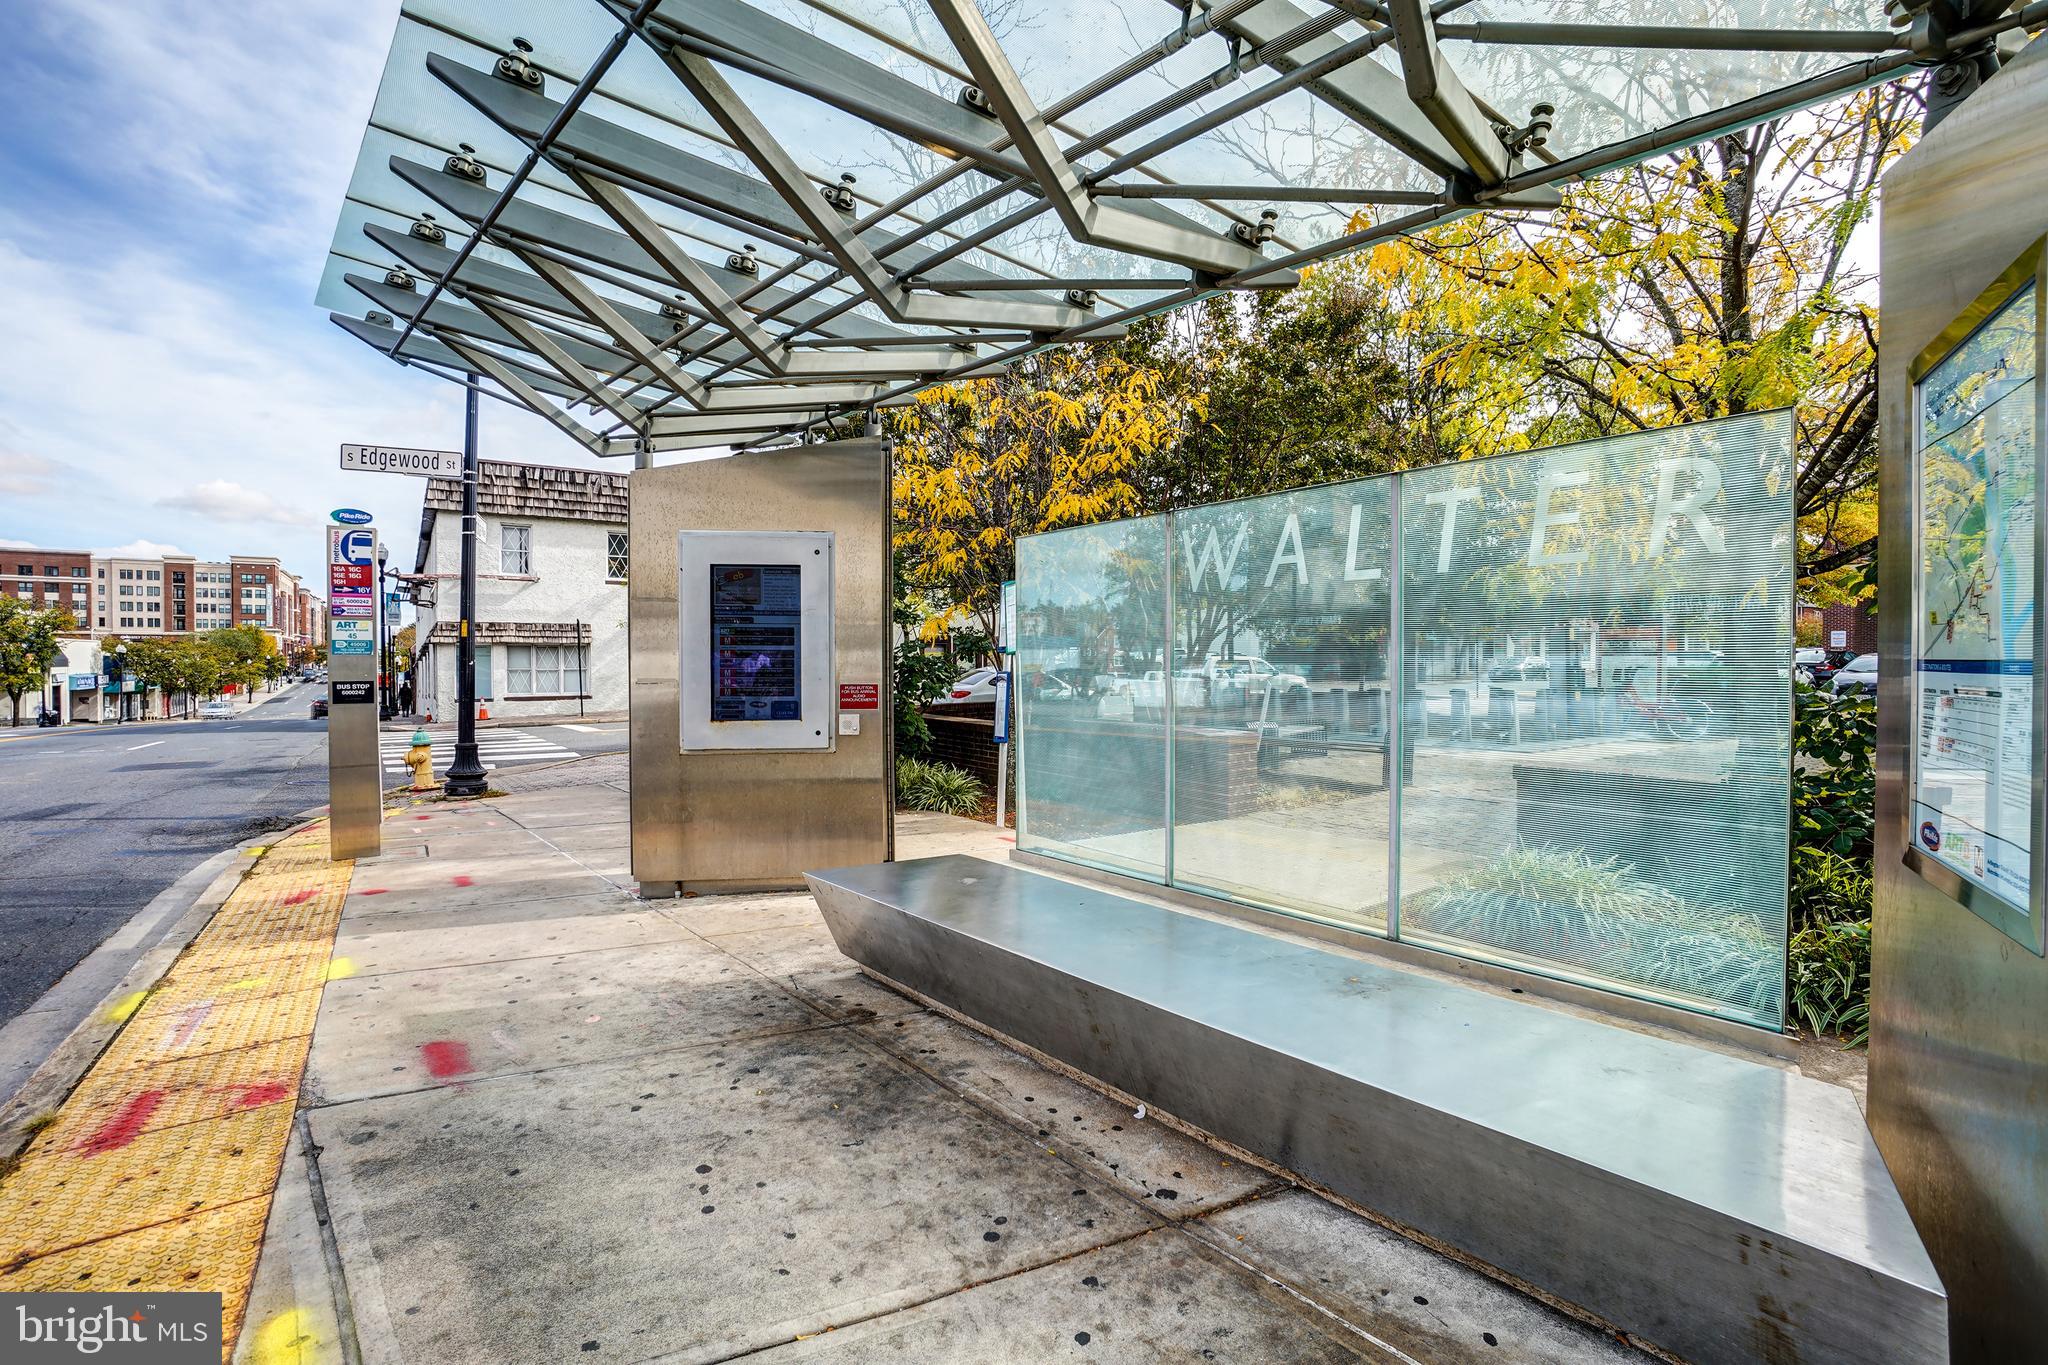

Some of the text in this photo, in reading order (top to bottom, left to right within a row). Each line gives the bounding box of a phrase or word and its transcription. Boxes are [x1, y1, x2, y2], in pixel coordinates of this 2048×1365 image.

[360, 447, 440, 471] Edgewood
[446, 460, 456, 470] St
[1181, 455, 1728, 593] WALTER
[357, 586, 370, 594] 16Y
